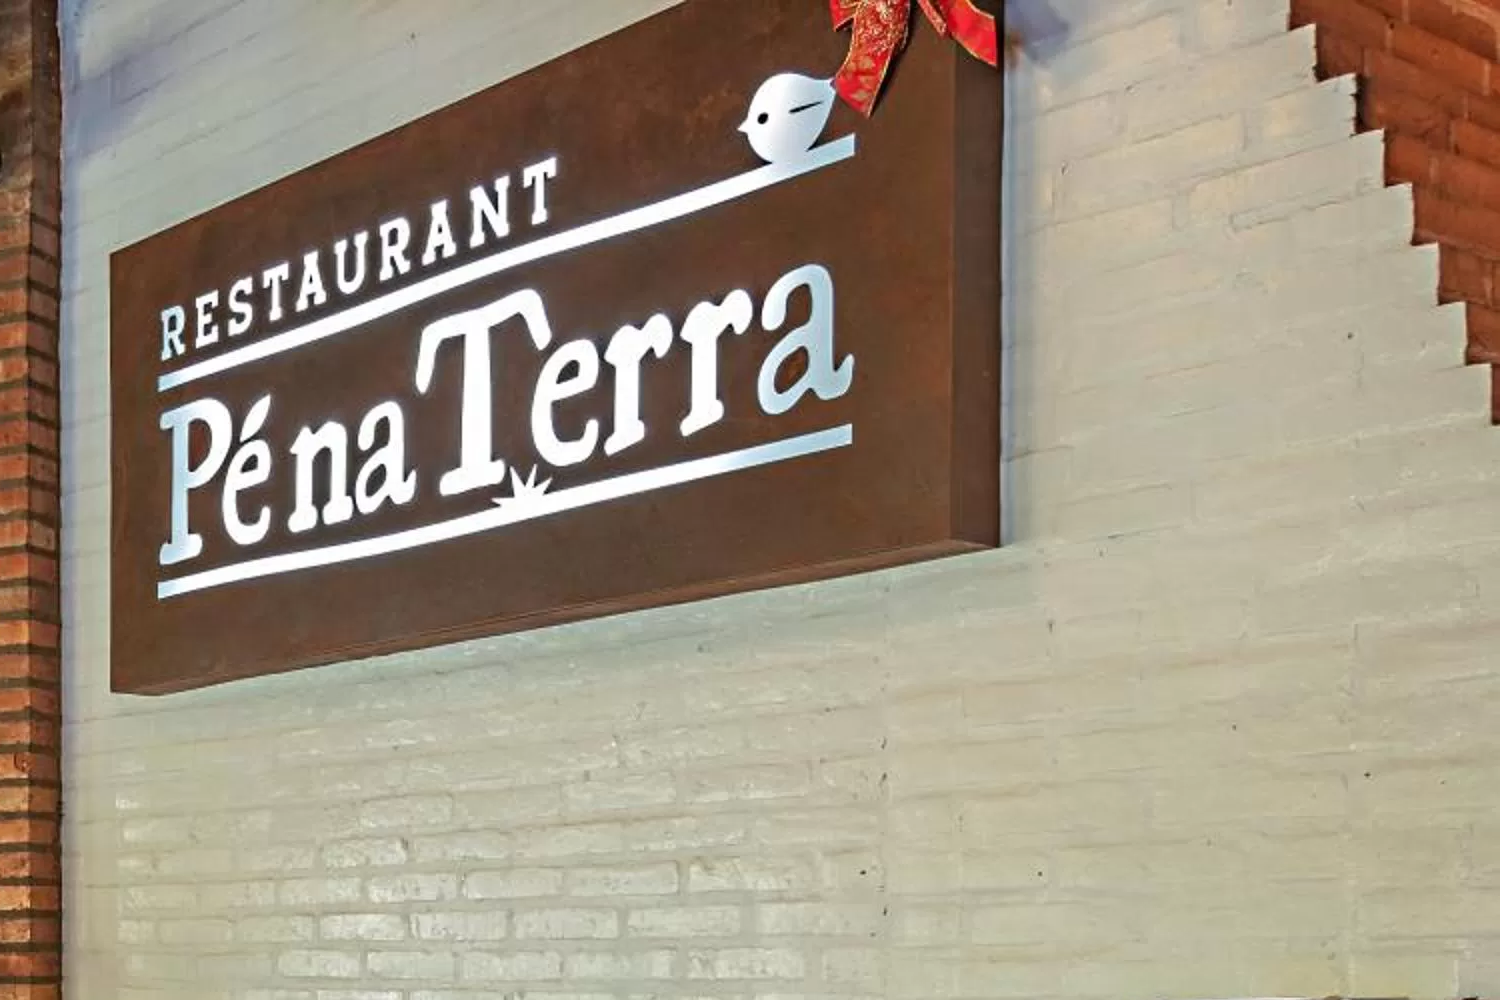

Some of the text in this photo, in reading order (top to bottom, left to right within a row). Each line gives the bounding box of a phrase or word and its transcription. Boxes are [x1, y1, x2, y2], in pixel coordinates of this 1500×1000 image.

[160, 156, 558, 361] RESTAURANT
[159, 262, 855, 566] Péna Terra
